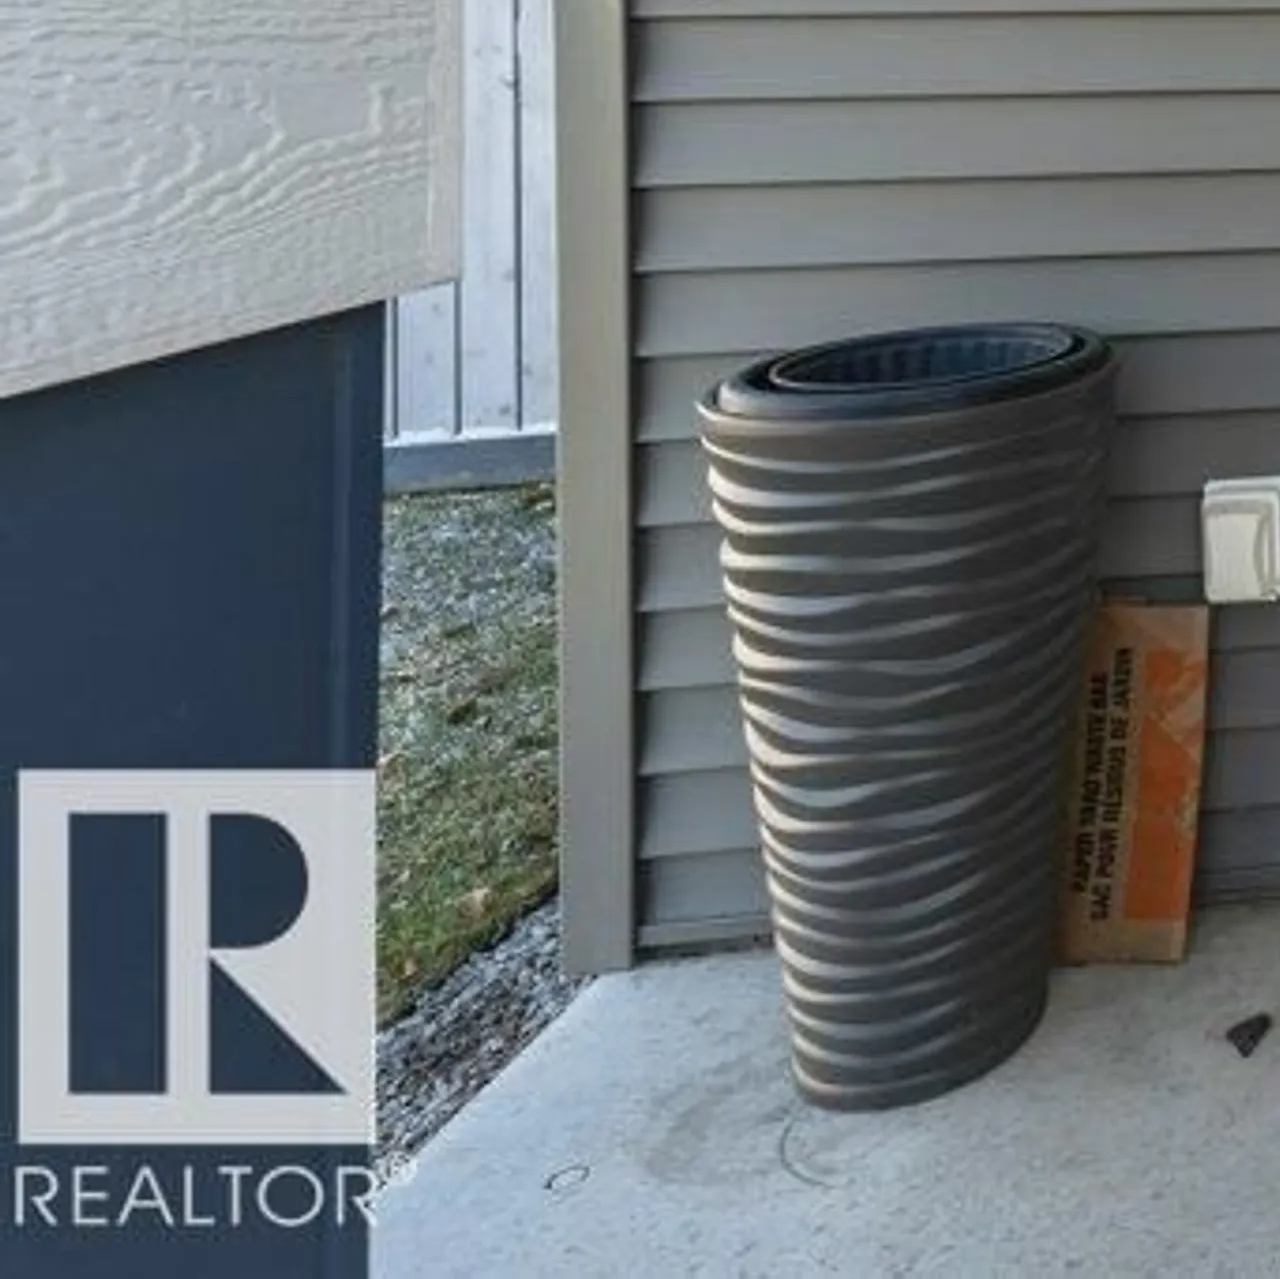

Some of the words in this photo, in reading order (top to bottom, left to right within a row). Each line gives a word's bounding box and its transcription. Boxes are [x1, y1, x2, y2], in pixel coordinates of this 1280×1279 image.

[1110, 716, 1128, 739] DE
[1094, 829, 1118, 878] POUR
[1090, 884, 1112, 920] SAC
